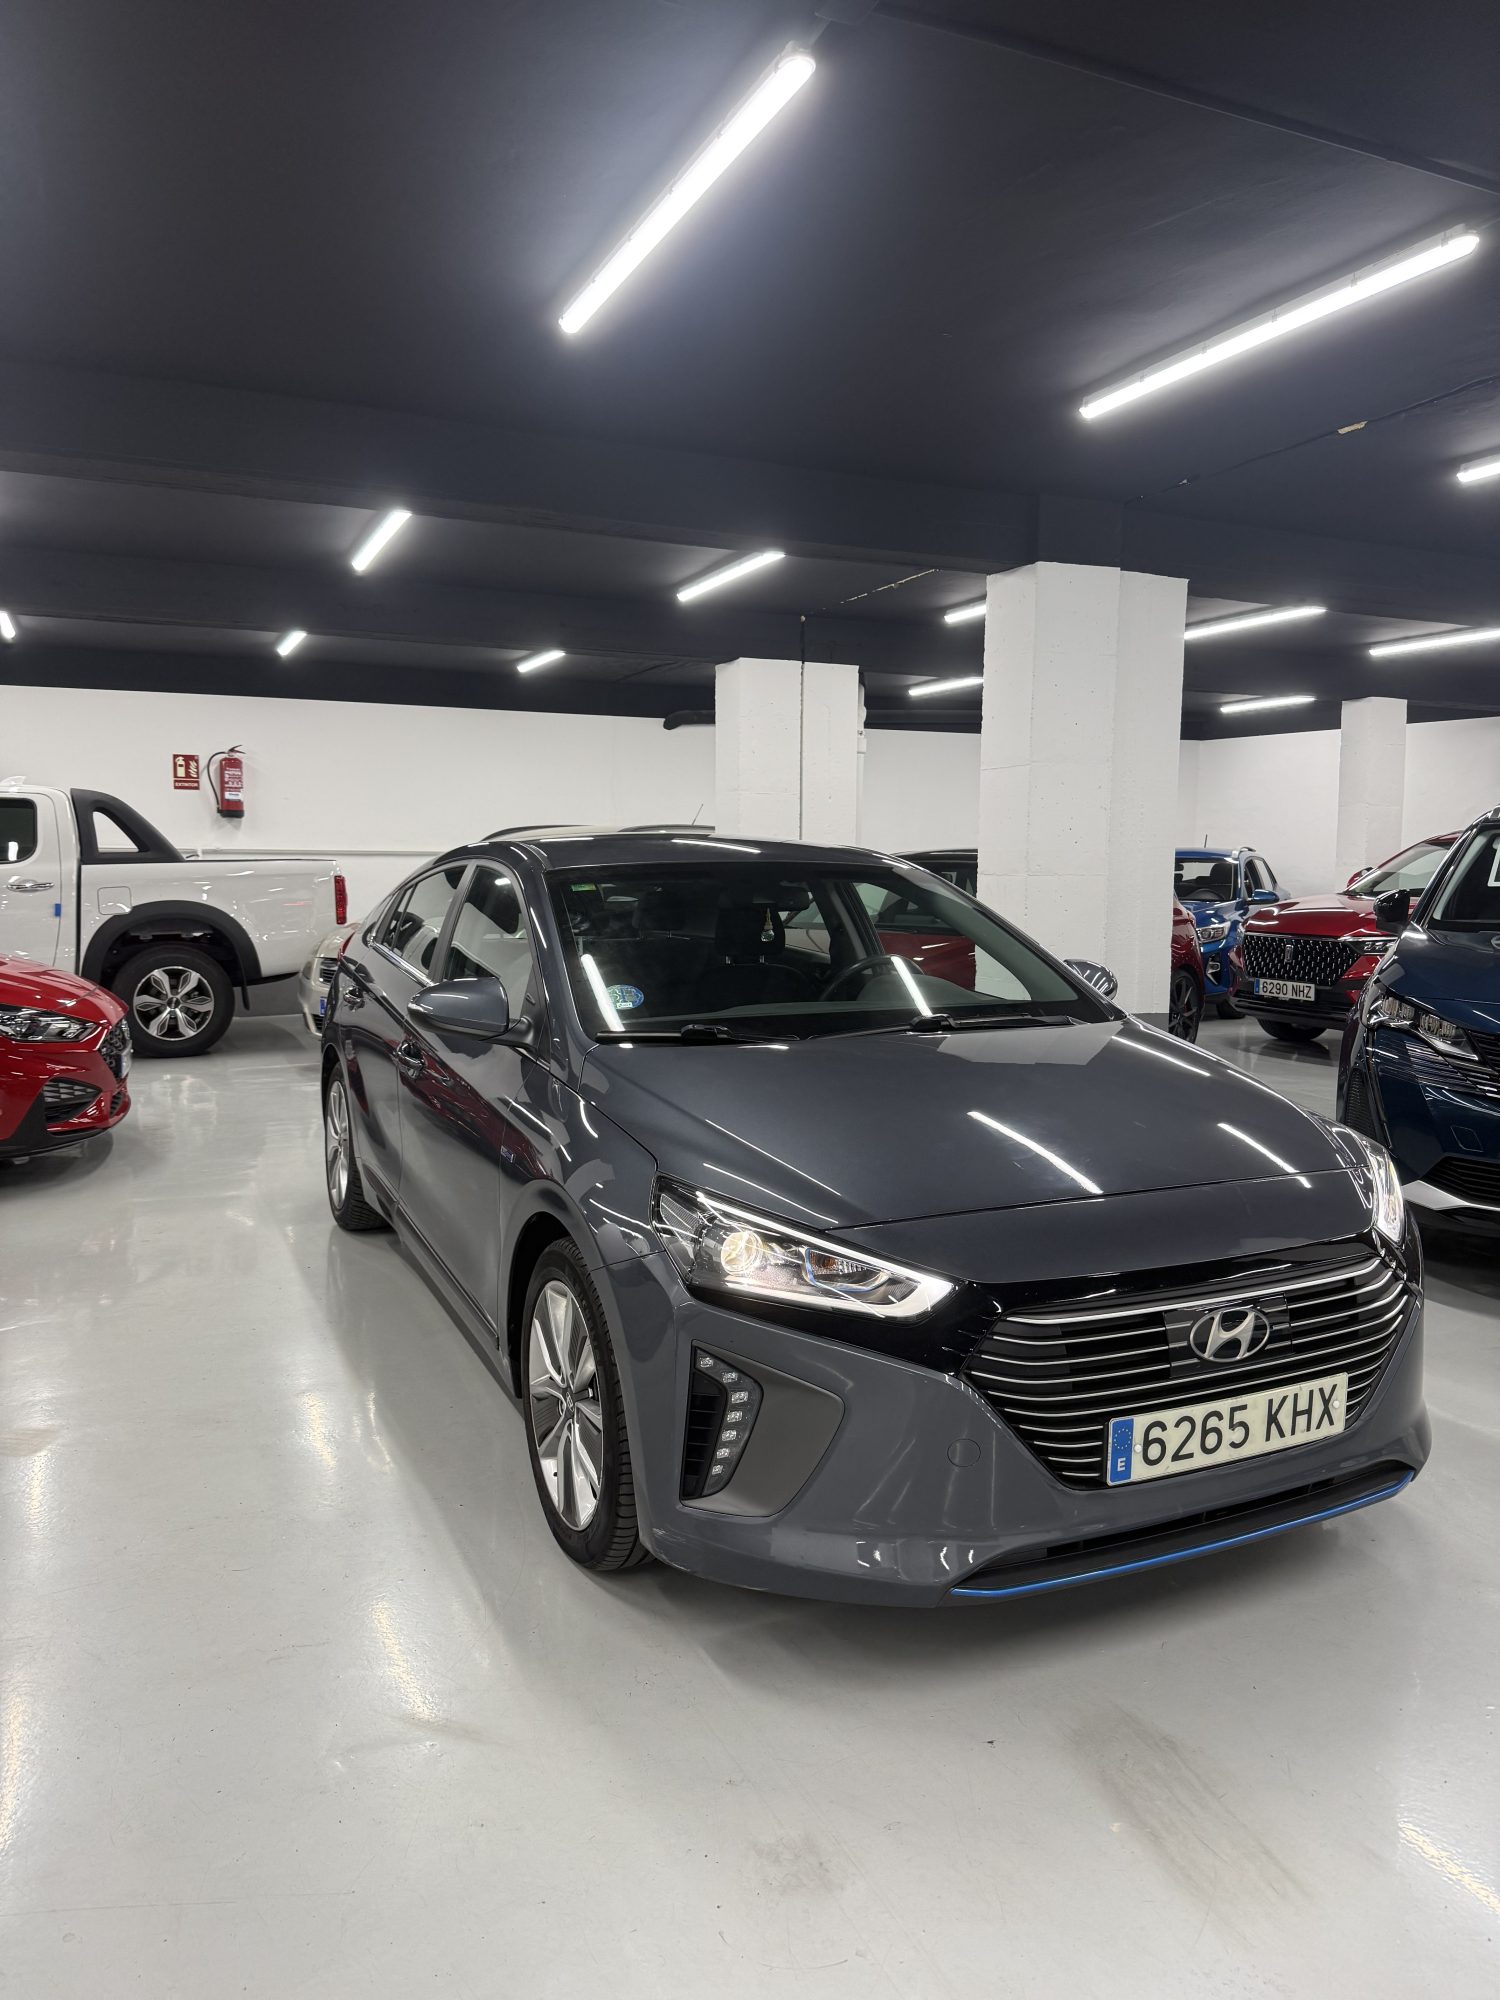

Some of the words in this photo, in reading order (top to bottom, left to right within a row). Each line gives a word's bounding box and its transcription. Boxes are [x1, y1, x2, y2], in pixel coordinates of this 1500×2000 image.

[1262, 981, 1288, 996] 6290
[1291, 984, 1312, 999] NHZ
[1117, 1457, 1126, 1472] E
[1142, 1404, 1250, 1466] 6265
[1265, 1383, 1338, 1442] KHX
